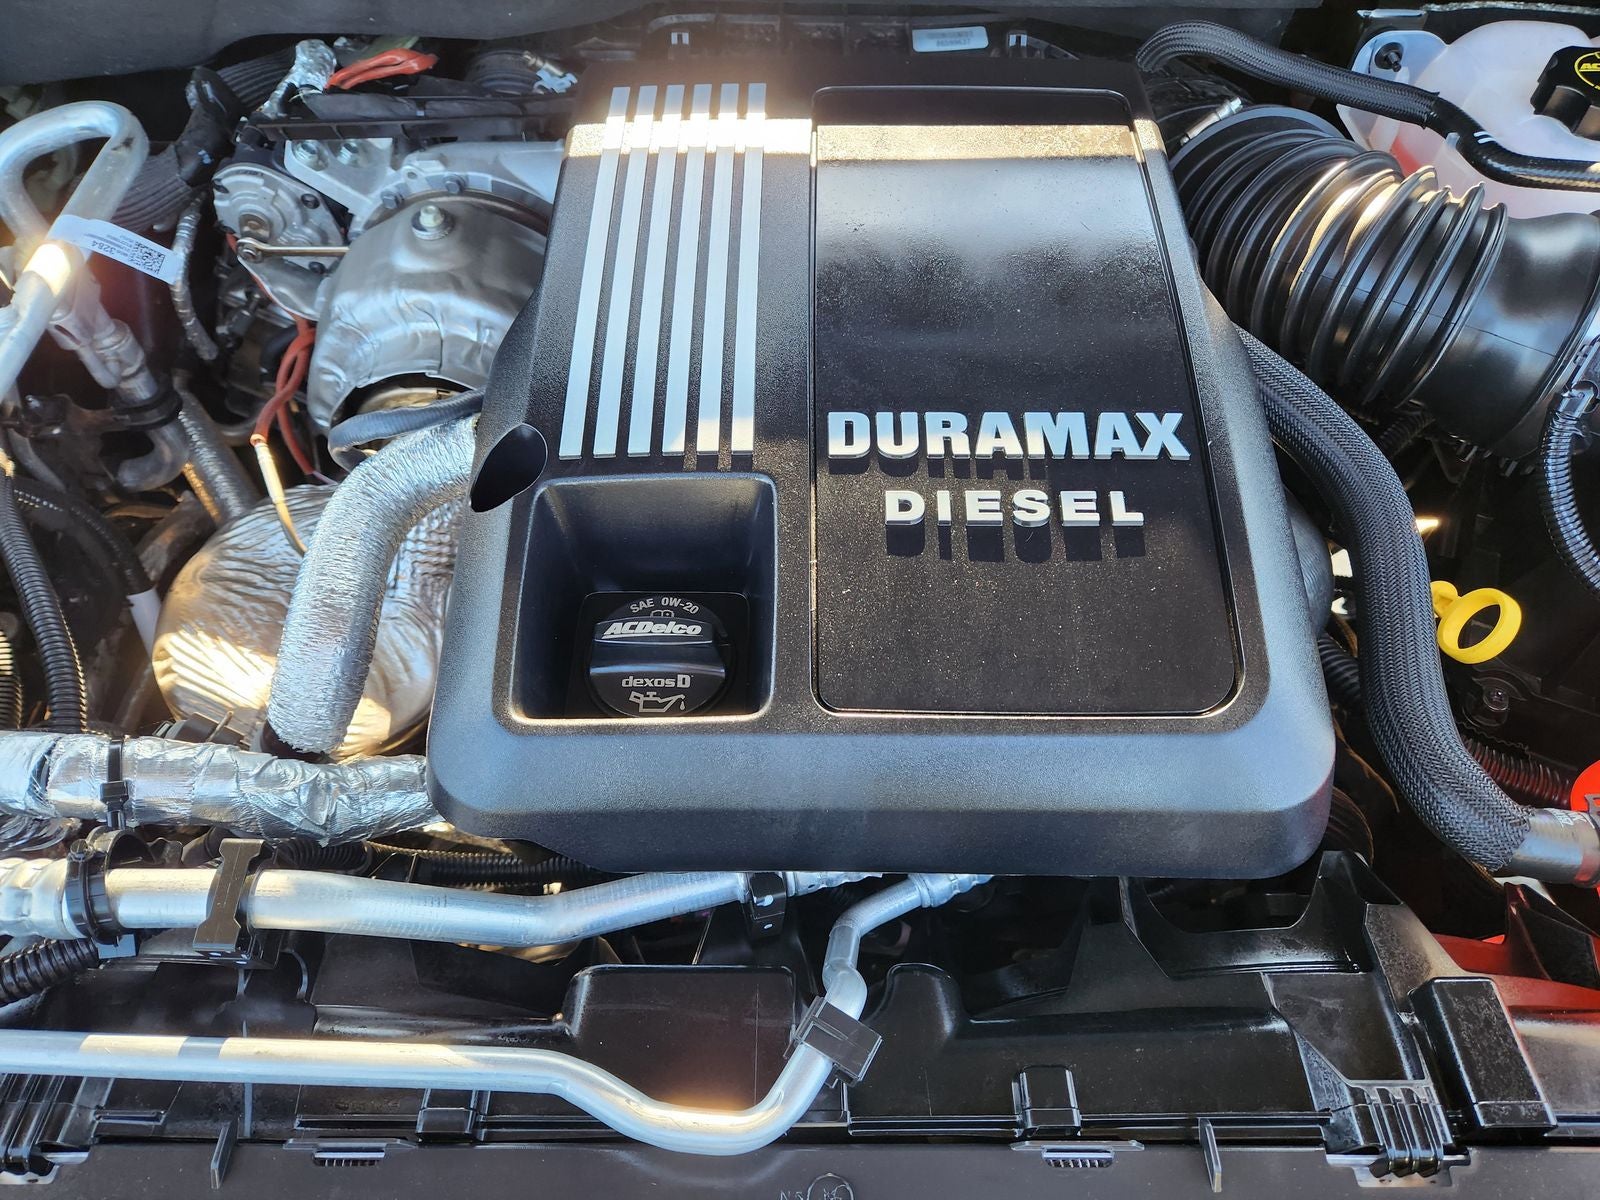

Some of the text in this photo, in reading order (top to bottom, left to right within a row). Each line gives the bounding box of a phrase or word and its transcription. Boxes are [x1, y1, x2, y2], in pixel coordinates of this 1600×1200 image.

[828, 411, 1191, 460] DURAMAX
[885, 490, 1144, 527] DIESEL
[630, 597, 699, 615] SAE 0W-20
[603, 621, 702, 636] ACDelco
